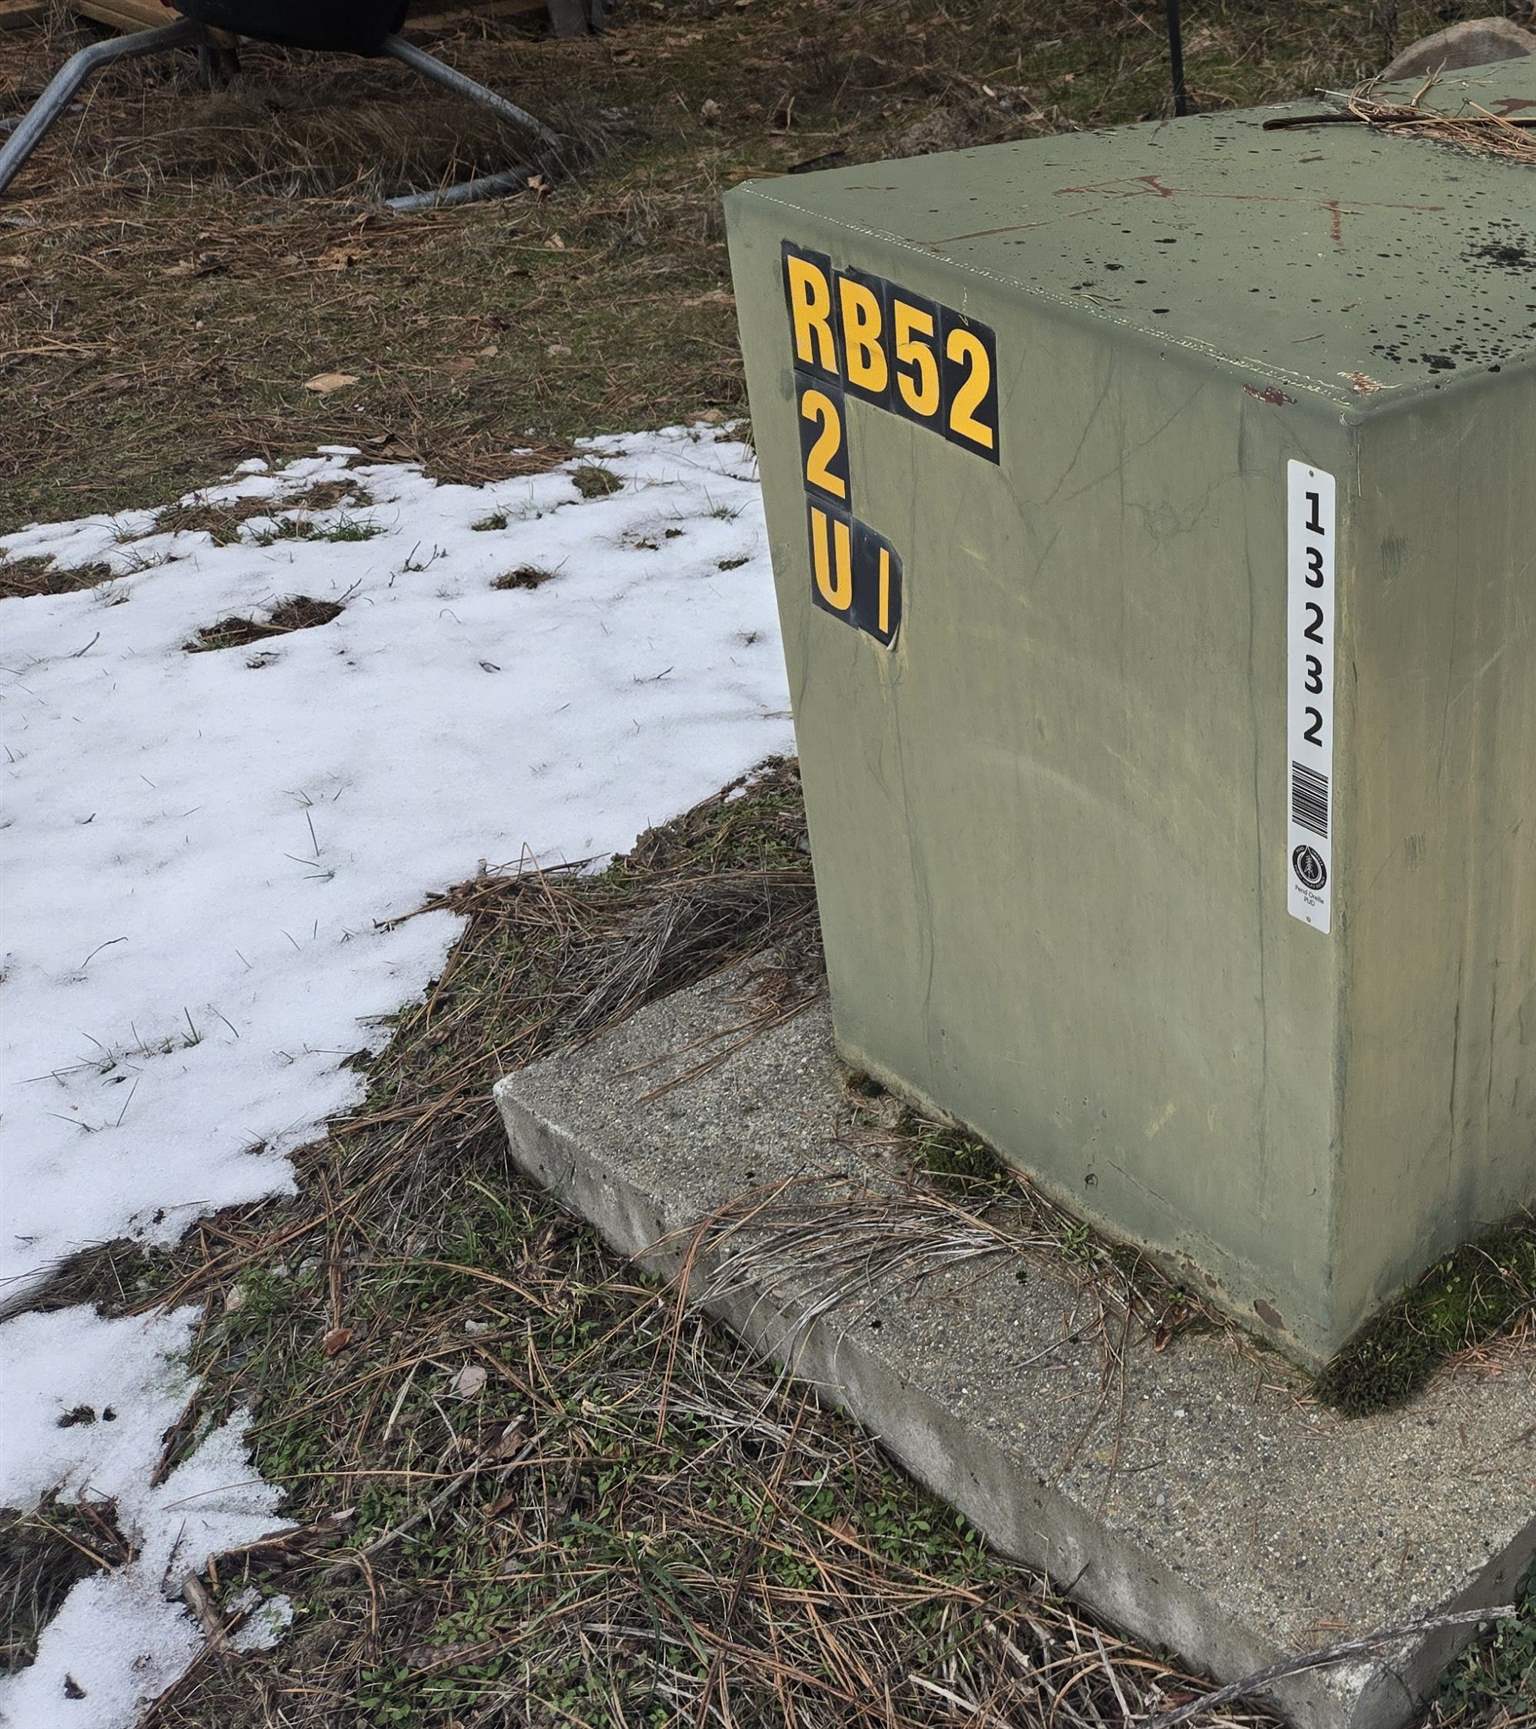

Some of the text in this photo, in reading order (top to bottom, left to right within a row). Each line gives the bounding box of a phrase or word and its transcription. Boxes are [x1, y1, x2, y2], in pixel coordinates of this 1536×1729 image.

[787, 255, 994, 449] RB52
[801, 389, 846, 499] 2
[1303, 491, 1325, 748] 13232
